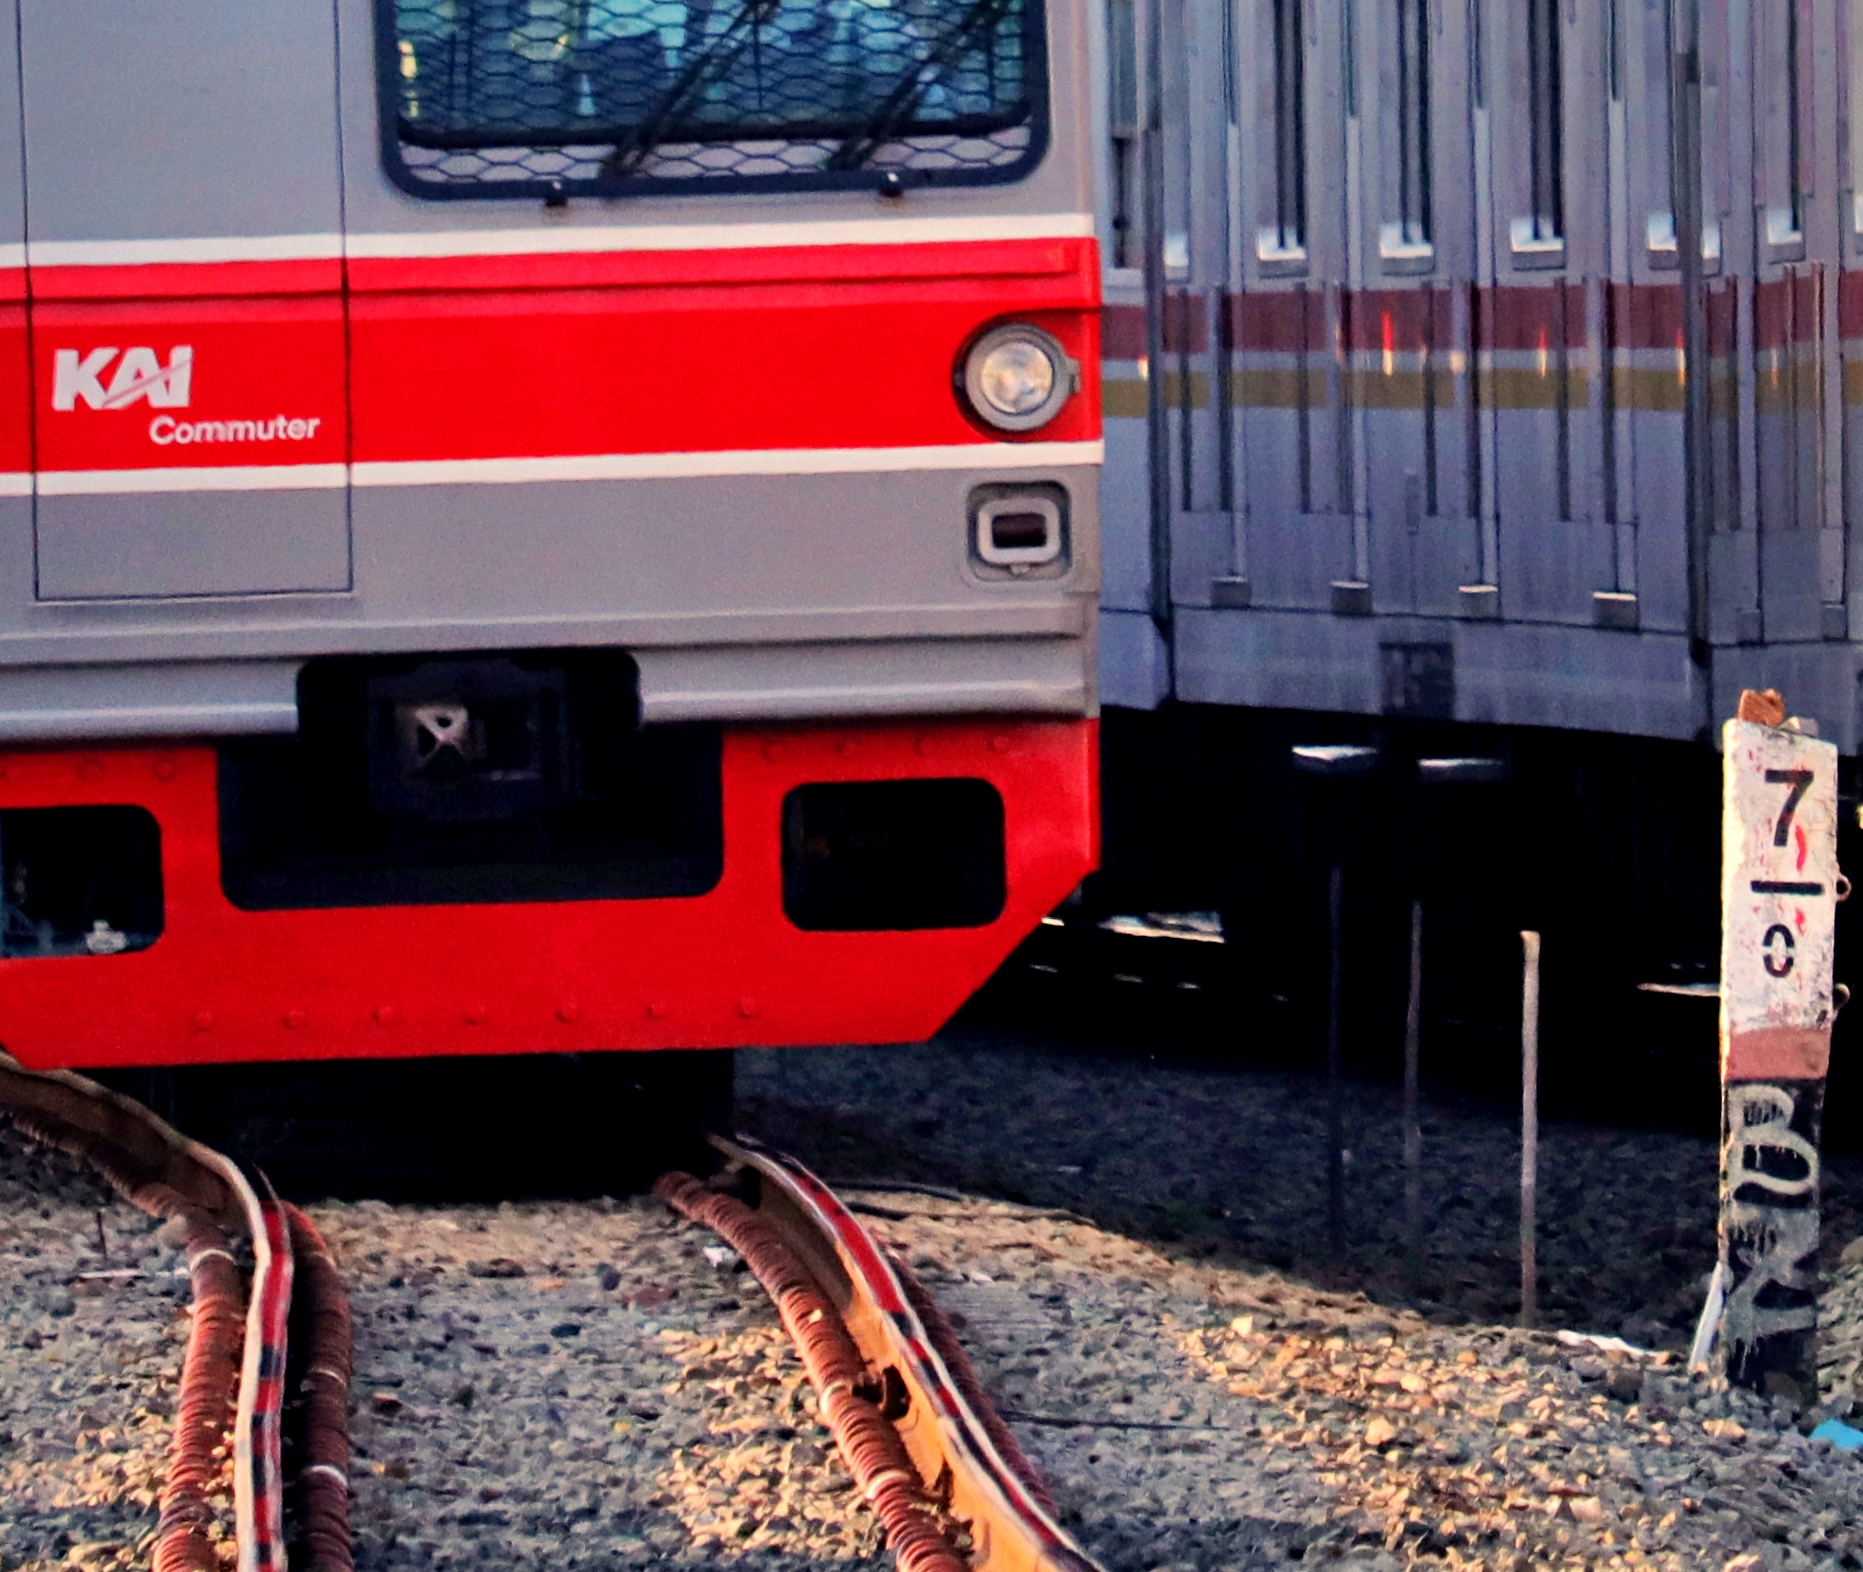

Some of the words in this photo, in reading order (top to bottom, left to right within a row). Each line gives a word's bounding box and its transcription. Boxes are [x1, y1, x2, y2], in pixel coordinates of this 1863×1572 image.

[51, 344, 194, 411] KAI
[148, 414, 321, 445] Commuter
[1763, 768, 1815, 848] 7
